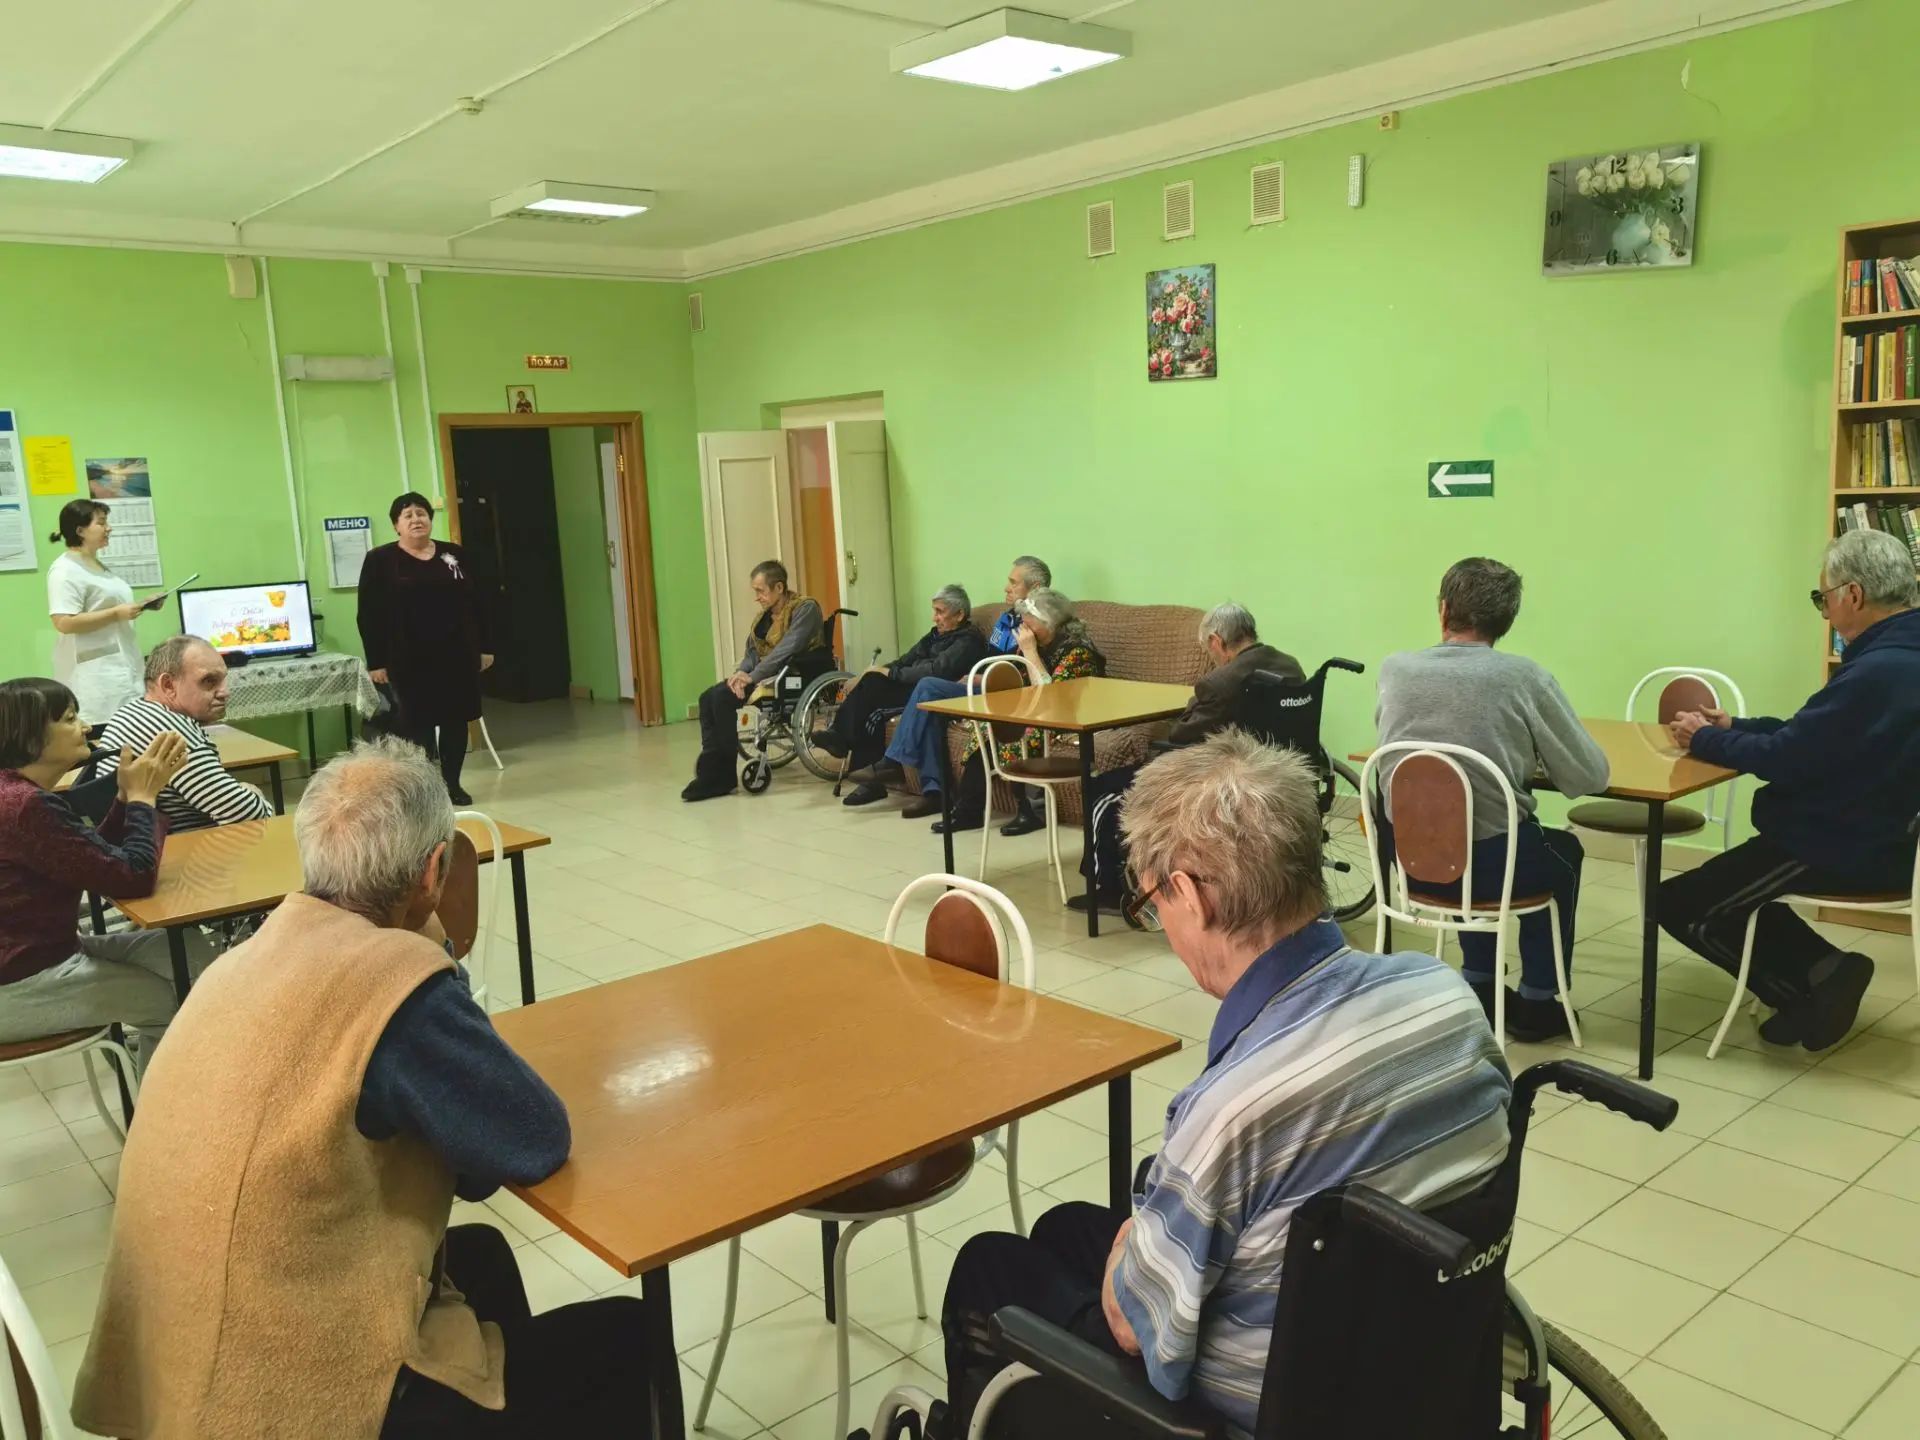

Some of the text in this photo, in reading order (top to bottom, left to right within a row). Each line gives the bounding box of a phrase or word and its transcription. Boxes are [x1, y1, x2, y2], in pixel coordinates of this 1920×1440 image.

[1610, 157, 1628, 175] 12
[1670, 196, 1684, 215] 3
[1605, 248, 1618, 265] 6
[530, 358, 566, 367] ПОЖАР
[327, 518, 367, 530] МЕНЮ
